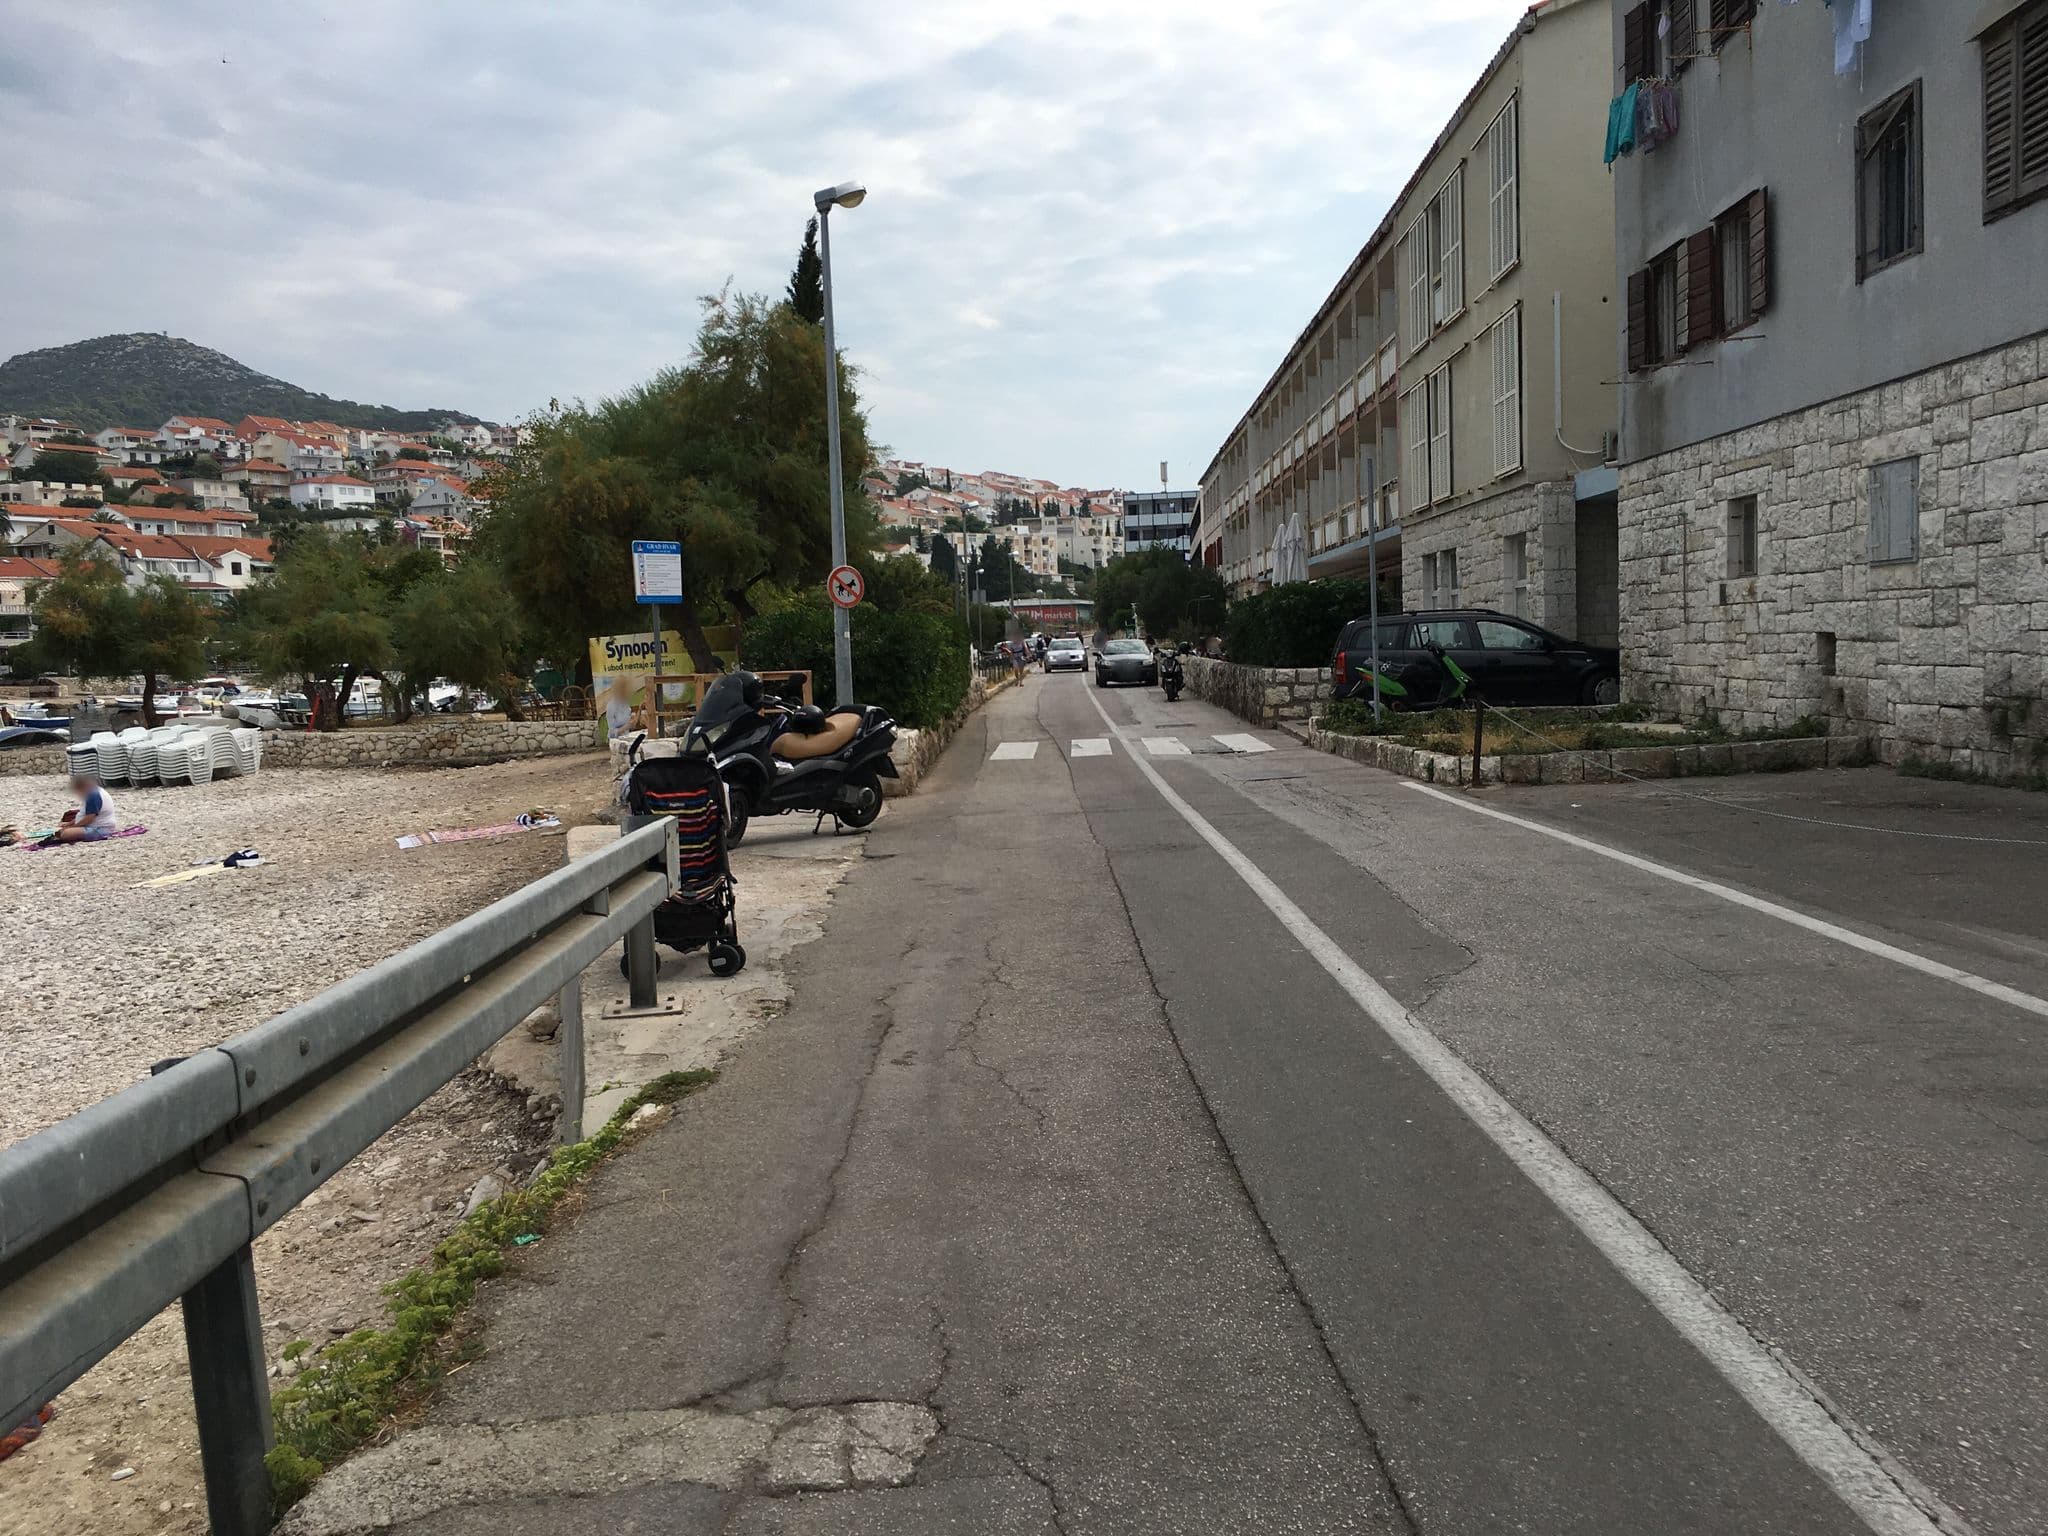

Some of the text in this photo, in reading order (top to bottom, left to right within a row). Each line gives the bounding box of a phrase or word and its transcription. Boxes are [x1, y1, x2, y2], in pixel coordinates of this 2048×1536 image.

[1044, 611, 1072, 619] market
[608, 662, 623, 672] ubod
[624, 660, 648, 671] nestaje
